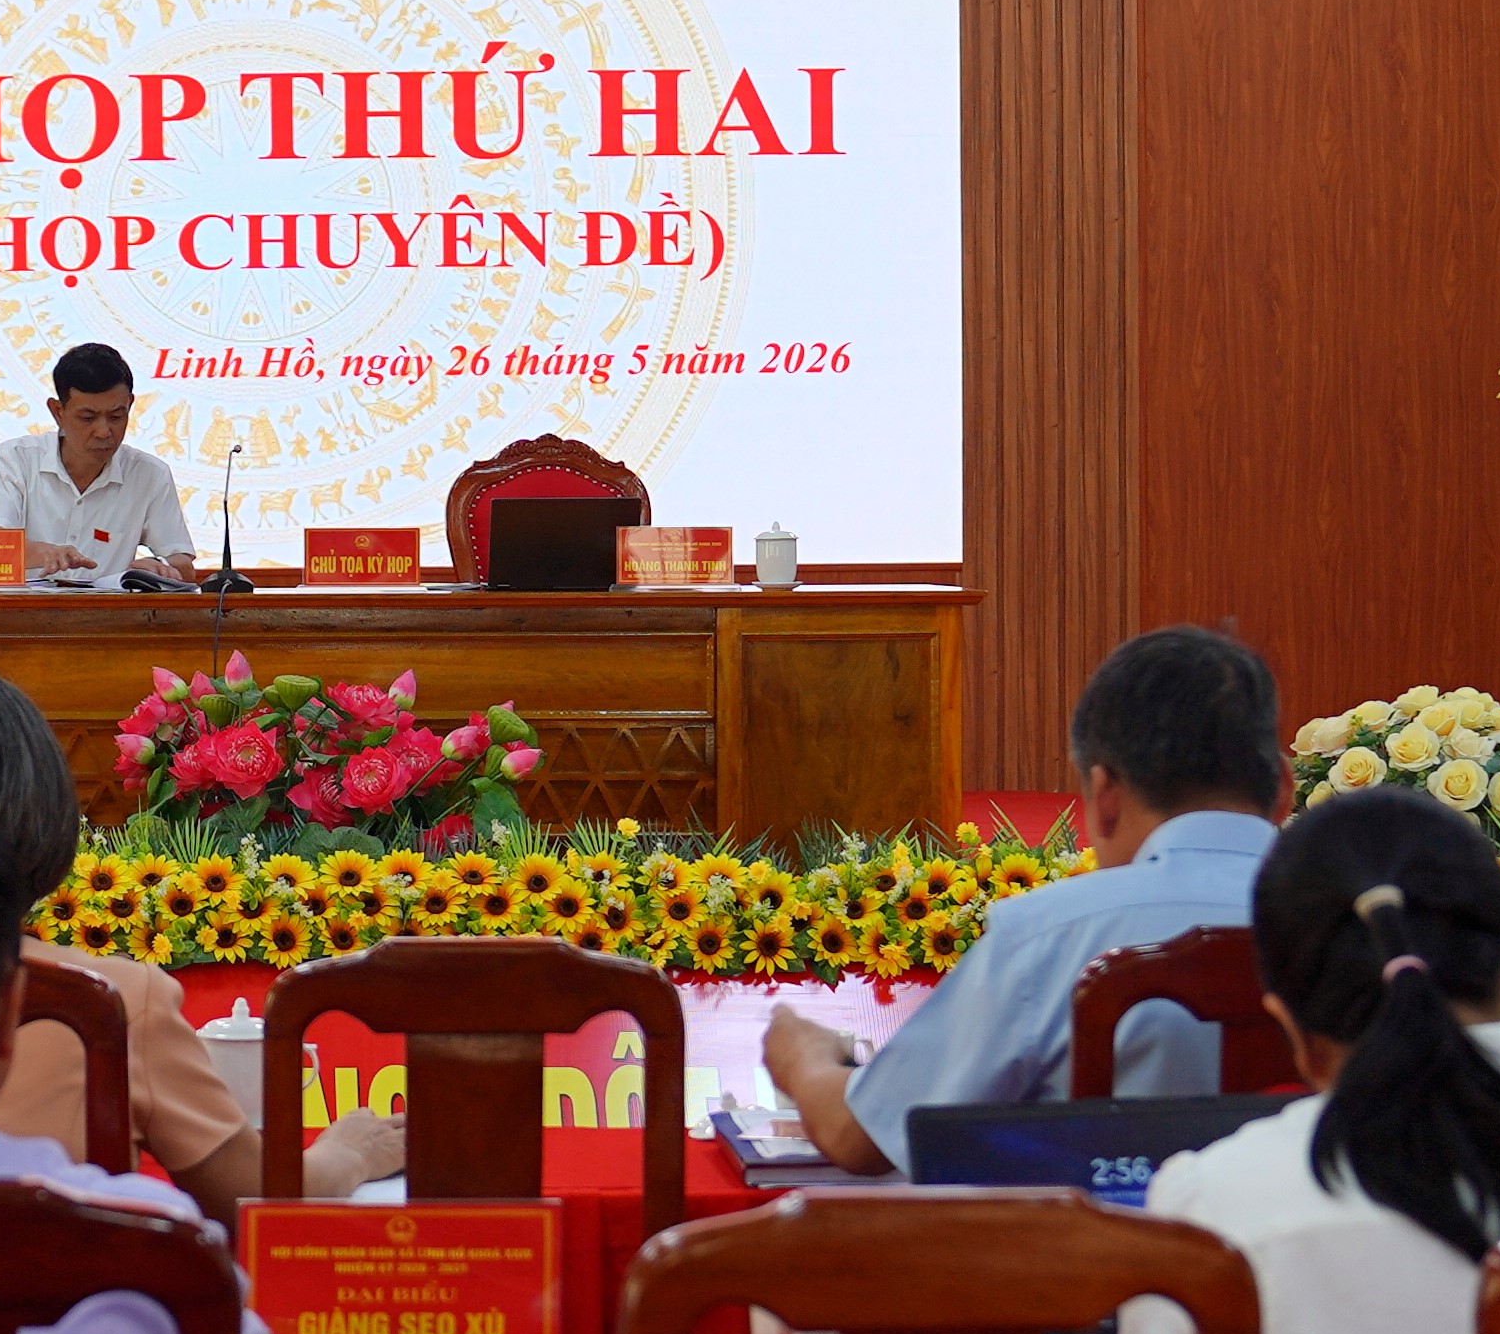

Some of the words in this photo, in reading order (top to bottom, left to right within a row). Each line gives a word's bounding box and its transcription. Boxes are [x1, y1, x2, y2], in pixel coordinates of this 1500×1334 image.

[239, 40, 556, 160] THỨ
[588, 67, 846, 157] HAI
[179, 195, 551, 270] CHUYÊN
[579, 193, 724, 279] ĐỀ)
[152, 347, 243, 379] Linh
[256, 338, 324, 383] Hồ,
[341, 345, 433, 385] ngày
[446, 345, 492, 376] 26
[503, 344, 615, 384] tháng
[628, 344, 650, 374] 5
[662, 343, 745, 374] năm
[758, 342, 852, 373] 2026
[311, 549, 337, 573] CHỦ
[367, 553, 383, 573] KỲ
[387, 556, 412, 577] HỌP
[1090, 1156, 1151, 1186] 2:56
